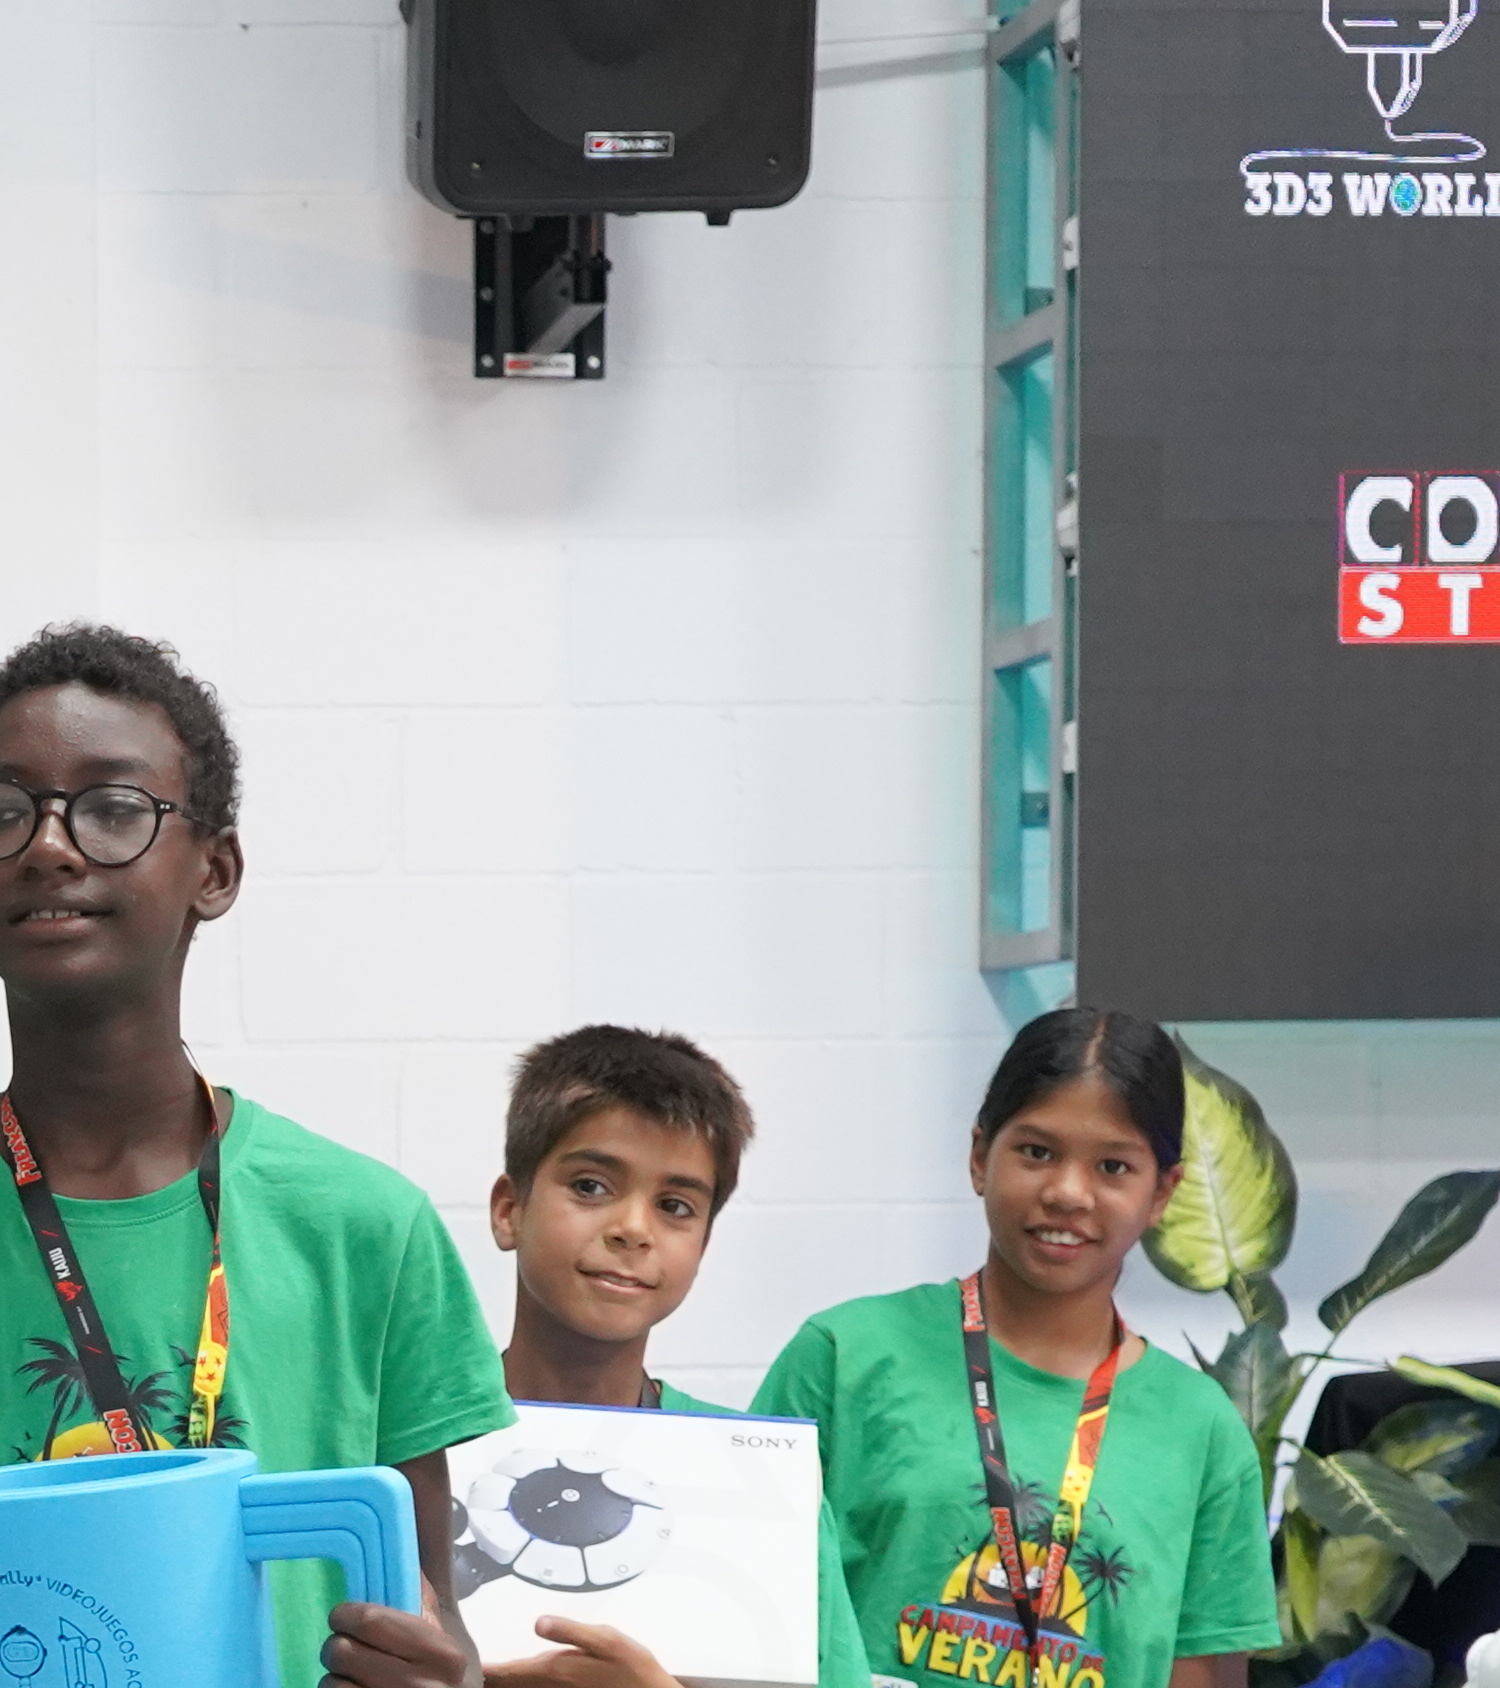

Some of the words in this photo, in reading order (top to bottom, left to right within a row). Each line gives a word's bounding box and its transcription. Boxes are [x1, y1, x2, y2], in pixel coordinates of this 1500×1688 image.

[1244, 172, 1333, 217] 3D3
[48, 1247, 72, 1279] KAIJU
[730, 1435, 798, 1451] SONY
[46, 1577, 139, 1664] VIDEOJUEGOS
